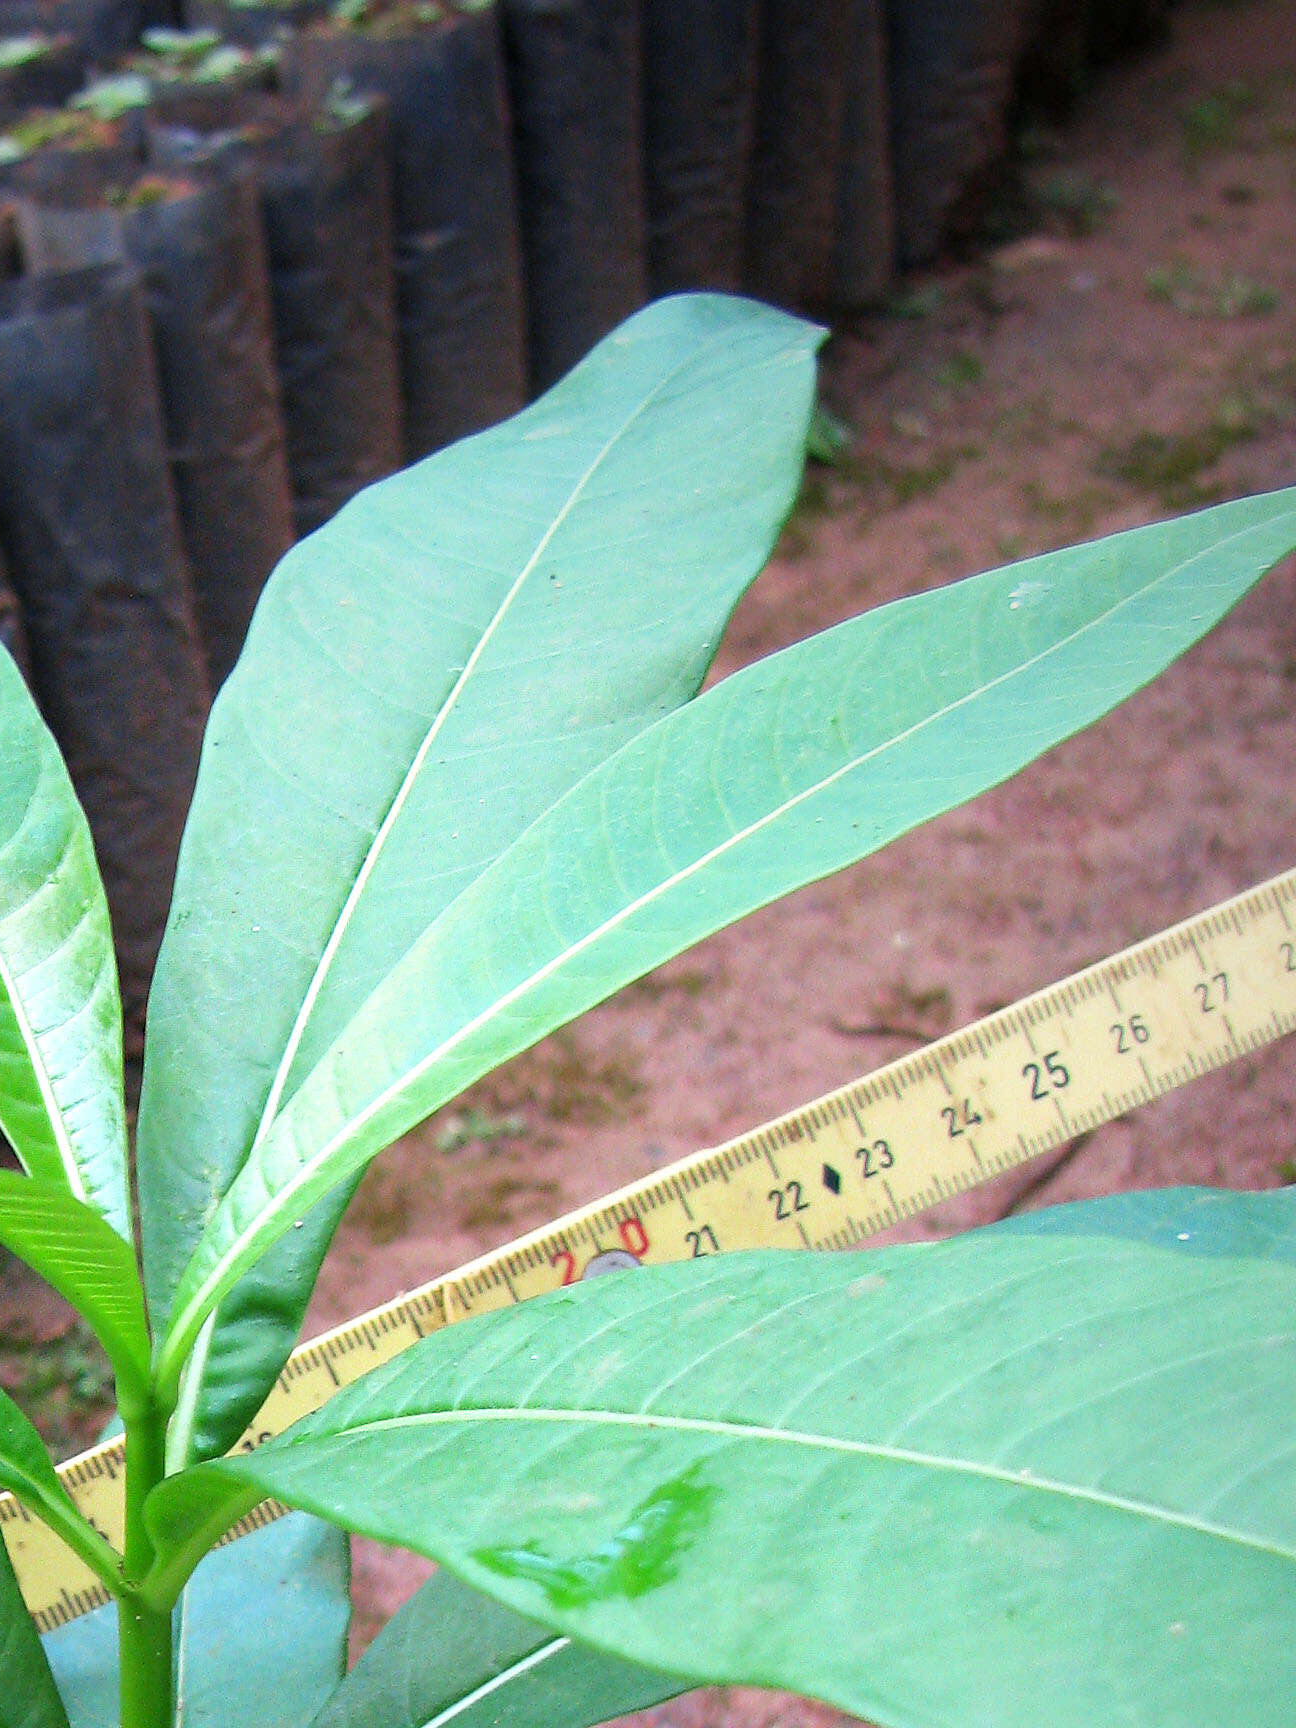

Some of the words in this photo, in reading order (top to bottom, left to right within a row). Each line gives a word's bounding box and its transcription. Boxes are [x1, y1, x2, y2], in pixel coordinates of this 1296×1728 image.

[686, 1224, 720, 1258] 21
[767, 1180, 811, 1222] 22
[855, 1138, 896, 1180] 23
[941, 1096, 983, 1138] 24
[1022, 1050, 1071, 1101] 25
[1108, 1014, 1149, 1055] 26
[1193, 971, 1229, 1013] 27
[1279, 942, 1296, 972] 2
